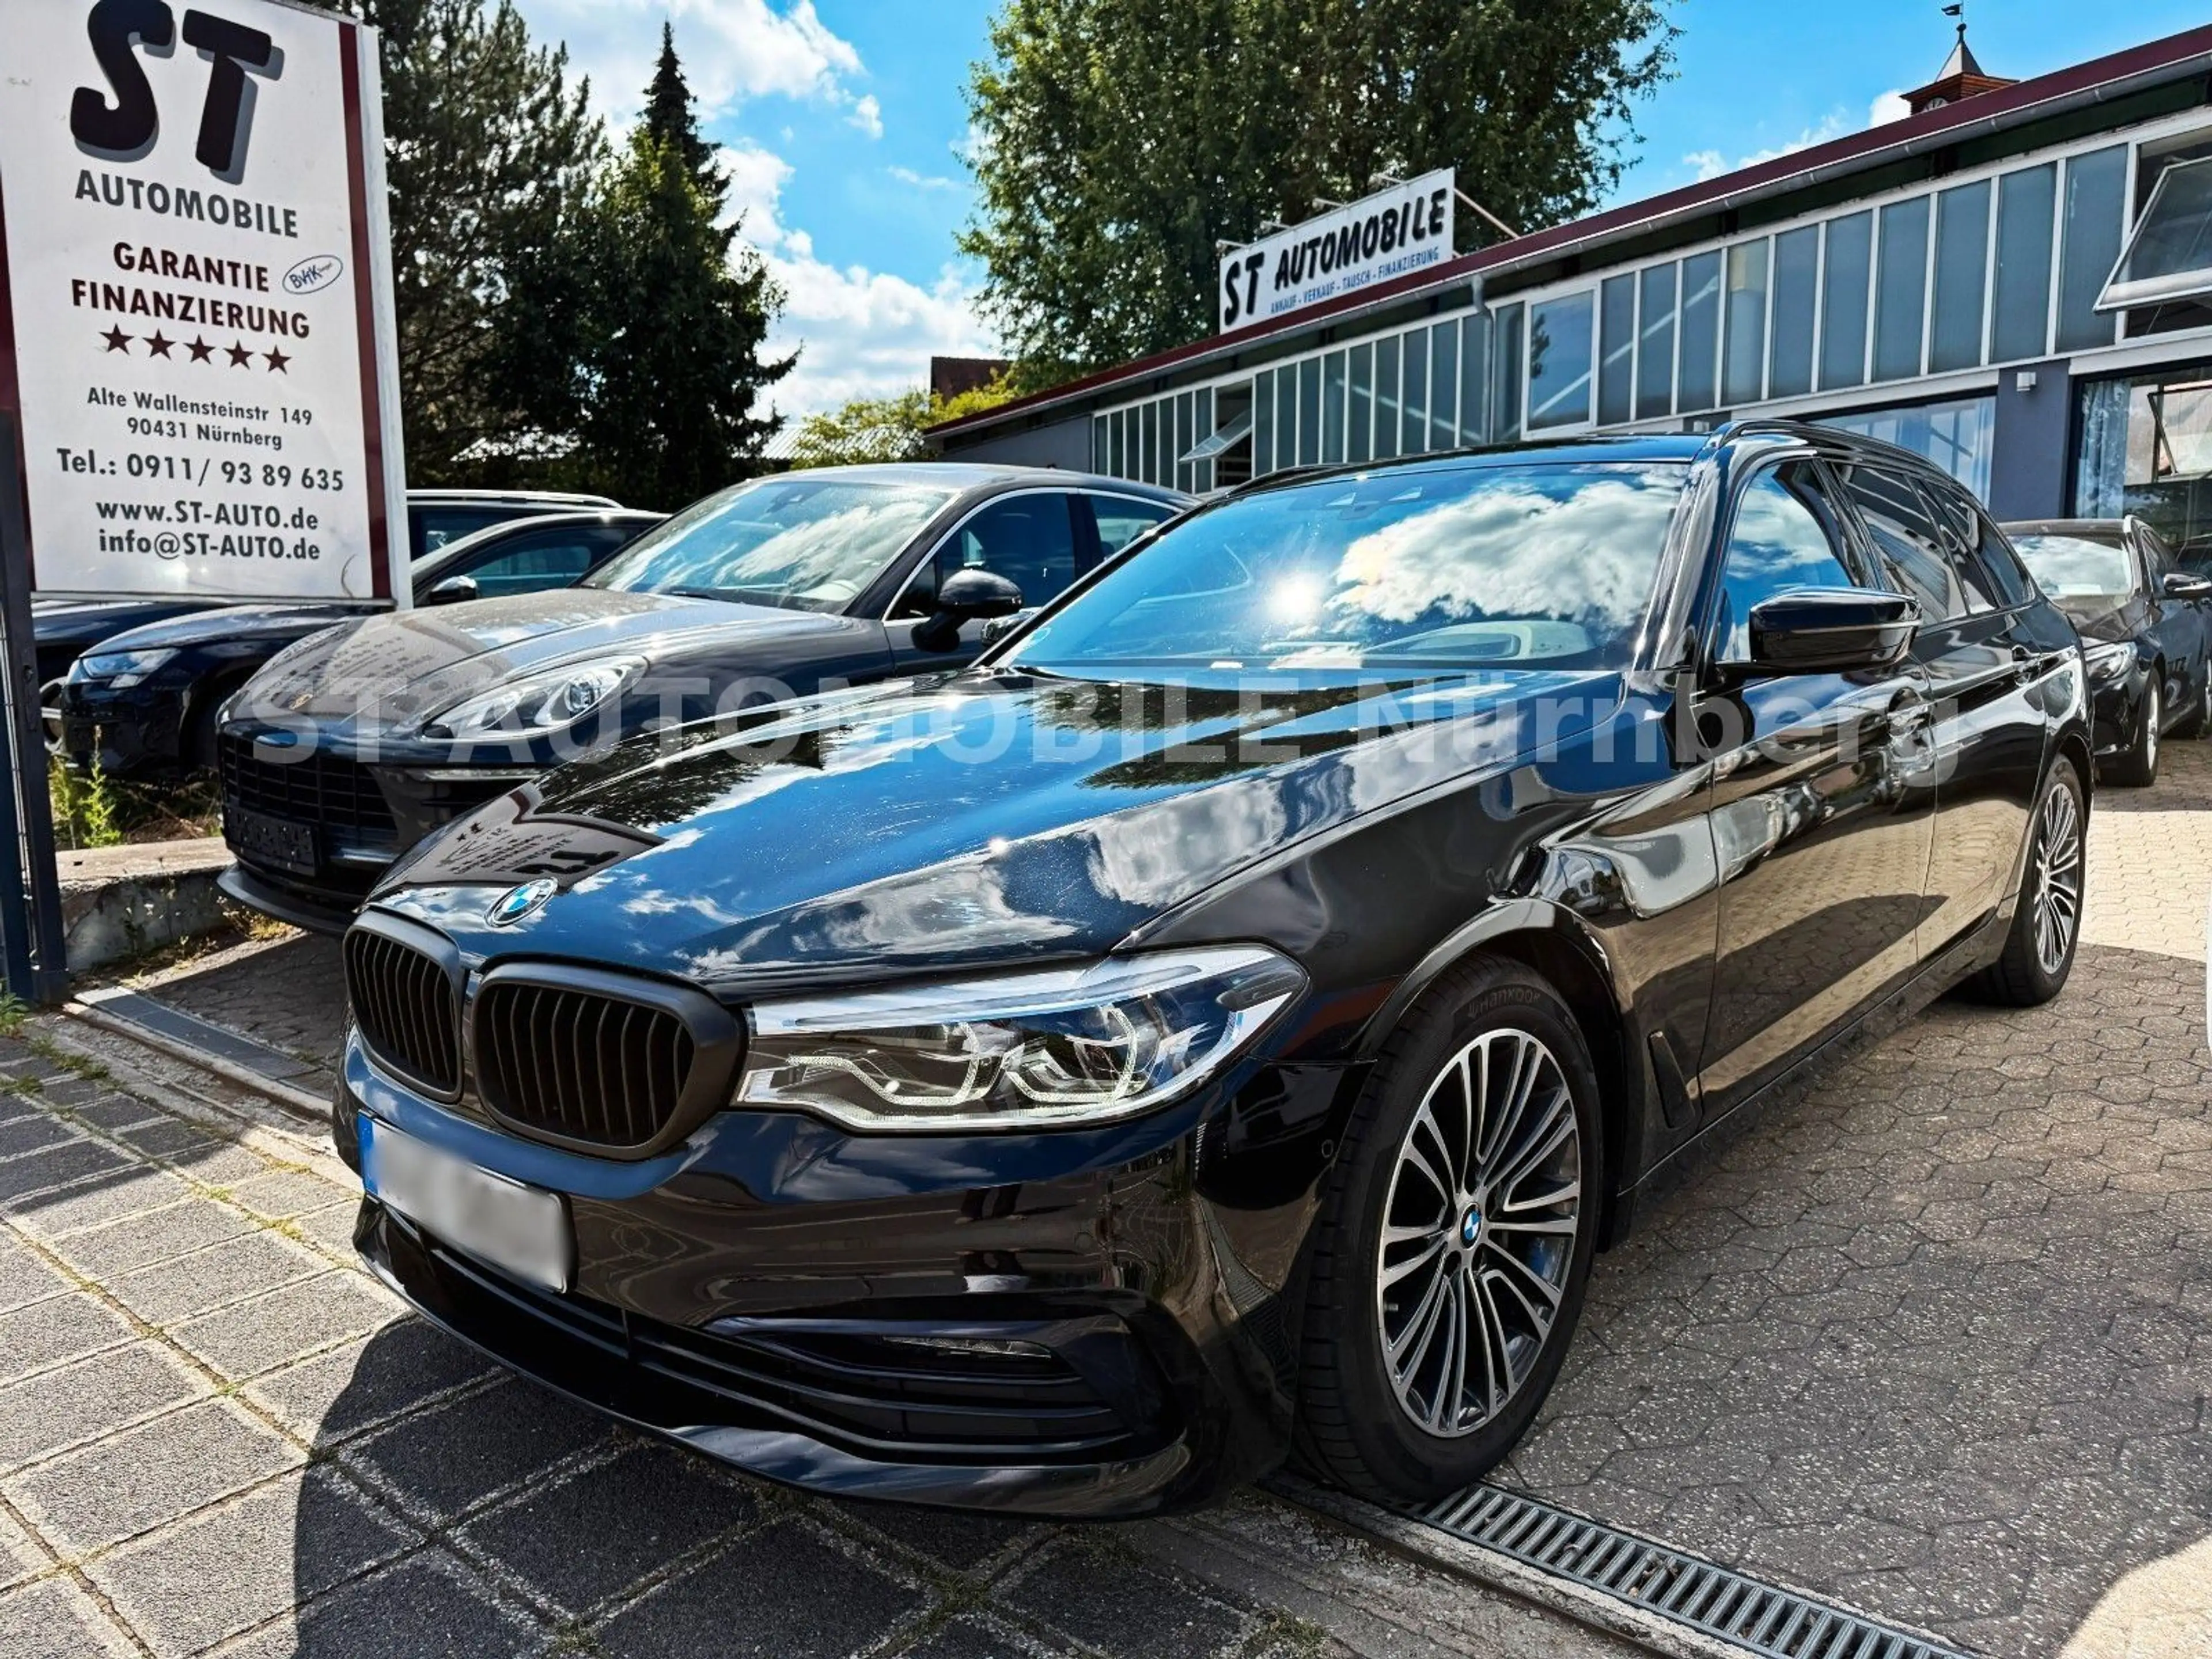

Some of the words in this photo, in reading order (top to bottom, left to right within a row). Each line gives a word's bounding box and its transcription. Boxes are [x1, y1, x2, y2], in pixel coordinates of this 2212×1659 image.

[70, 0, 285, 184] ST
[75, 169, 297, 238] AUTOMOBILE
[113, 242, 268, 292] GARANTIE
[1225, 252, 1264, 325] ST
[1275, 188, 1446, 290] AUTOMOBILE
[1271, 295, 1297, 314] ANKAUF
[1304, 282, 1335, 303] VERKAUF
[1343, 271, 1370, 290] TAUSCH
[1378, 247, 1439, 278] FINANZIERUNG
[72, 279, 309, 338] FINANZIERUNG
[88, 388, 126, 407] Alte
[134, 392, 268, 421] Wallensteinstr
[281, 408, 312, 425] 149
[127, 418, 186, 438] 90431
[197, 424, 281, 450] Nürnberg
[57, 448, 116, 475] Tel.:
[221, 461, 252, 484] 93
[263, 464, 291, 487] 89
[302, 468, 343, 491] 635
[96, 501, 318, 529] www.ST-AUTO.de
[100, 529, 320, 560] info@ST-AUTO.de
